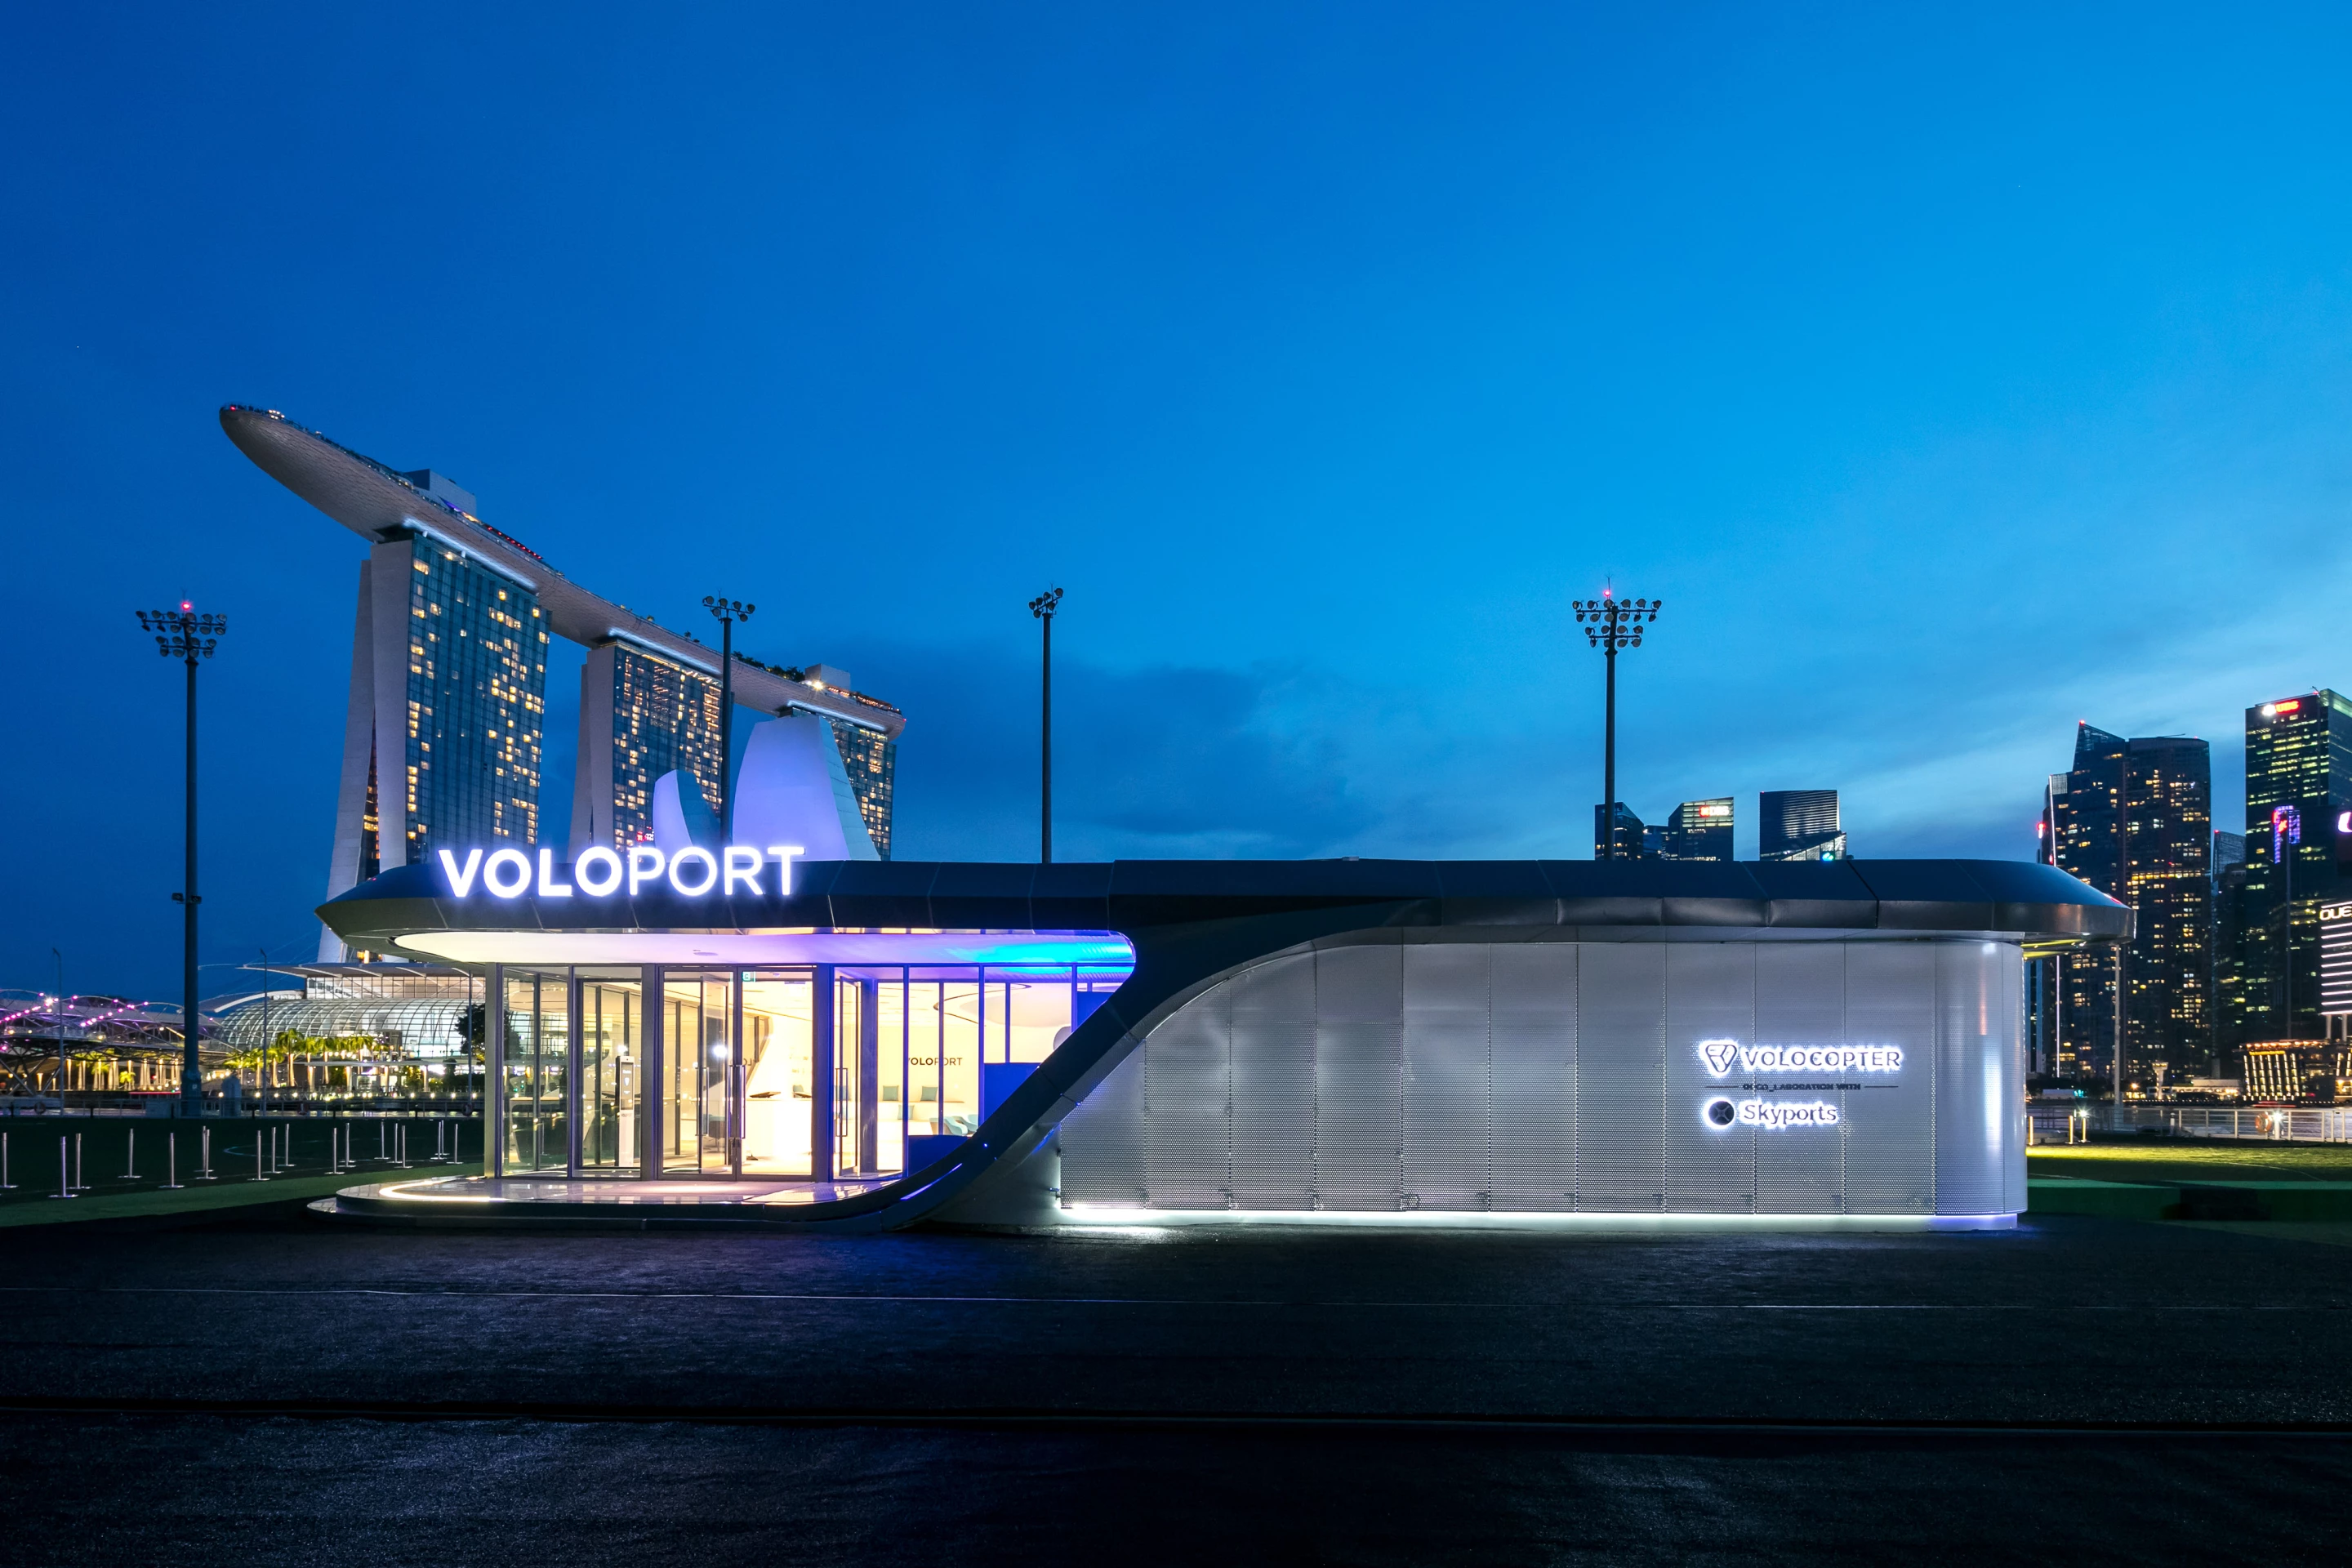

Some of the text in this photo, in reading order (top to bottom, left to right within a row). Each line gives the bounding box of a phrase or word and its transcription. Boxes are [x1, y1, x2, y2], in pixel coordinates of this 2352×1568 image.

[438, 846, 806, 898] VOLOPORT
[908, 1057, 963, 1066] OLOPORT
[1744, 1051, 1900, 1067] VOLOCOPTER
[1755, 1083, 1833, 1092] COLABORATION
[1744, 1104, 1837, 1125] Skyports
